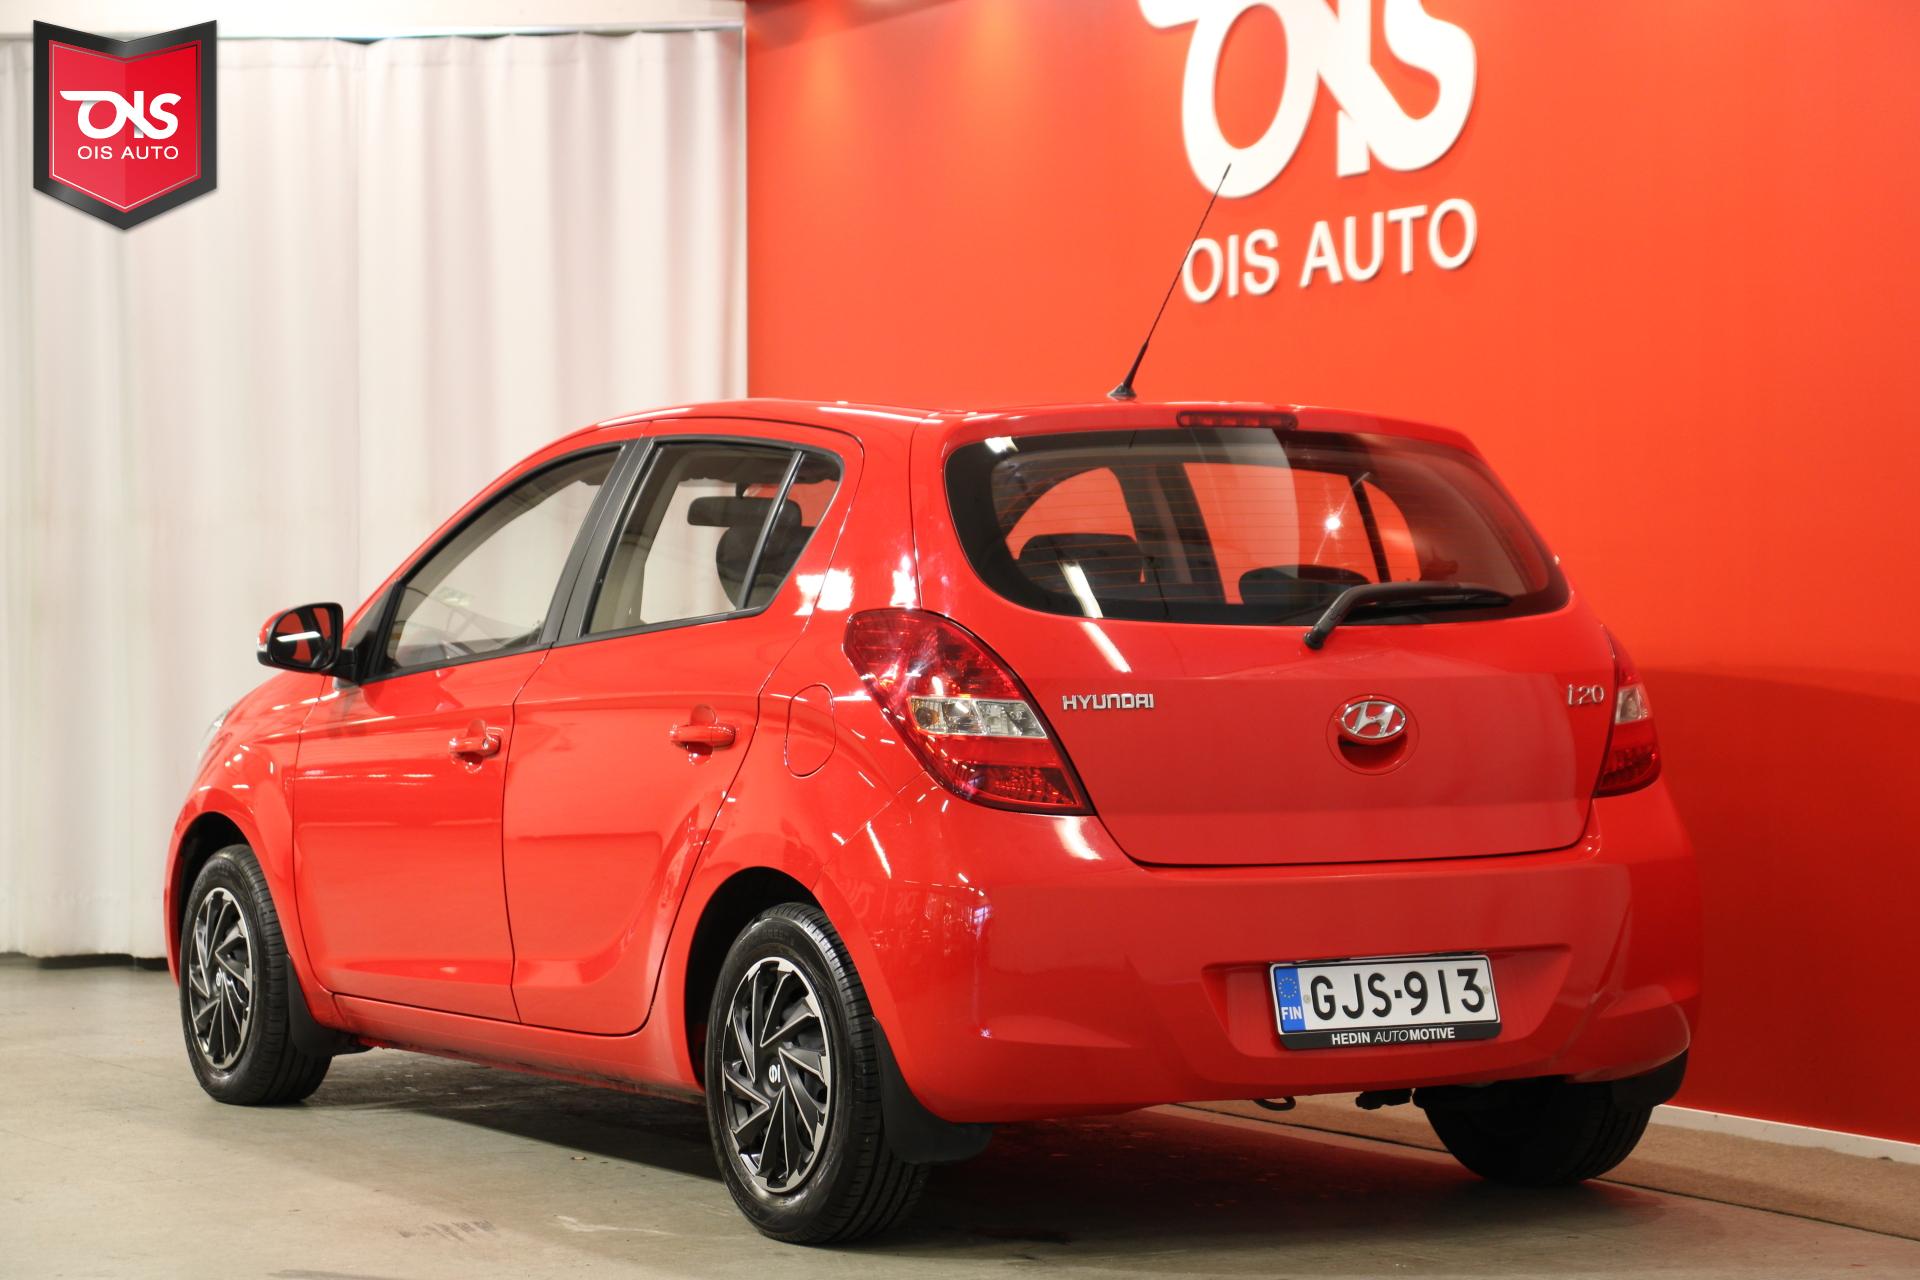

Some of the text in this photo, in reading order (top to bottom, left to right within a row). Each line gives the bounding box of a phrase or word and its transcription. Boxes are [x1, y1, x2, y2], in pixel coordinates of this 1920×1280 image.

[1182, 198, 1477, 303] OIS AUTO
[1062, 693, 1154, 710] HYUNDAI
[1567, 684, 1605, 706] i20
[1281, 1006, 1303, 1020] FIN
[1332, 1027, 1456, 1045] HEDIN AUTOMOTIVE
